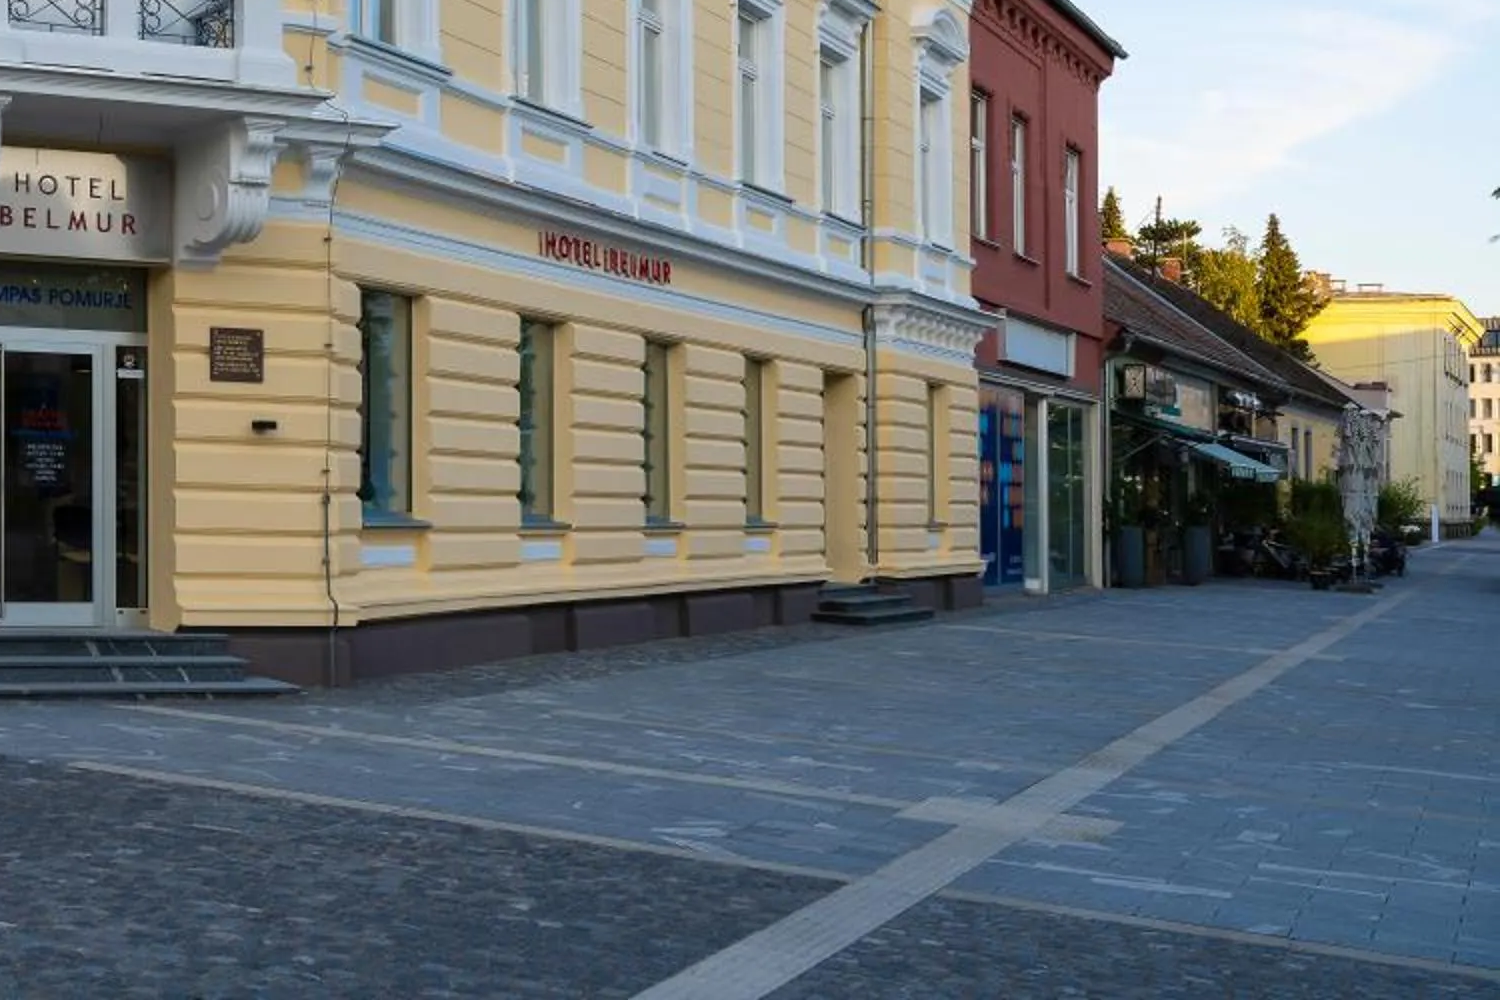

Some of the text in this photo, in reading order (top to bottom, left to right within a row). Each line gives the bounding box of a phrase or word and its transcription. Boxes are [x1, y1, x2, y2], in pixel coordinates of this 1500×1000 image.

[14, 172, 125, 201] HOTEL
[0, 204, 138, 236] BELMUR
[539, 231, 601, 268] HOTEL
[49, 289, 133, 309] POMURJE
